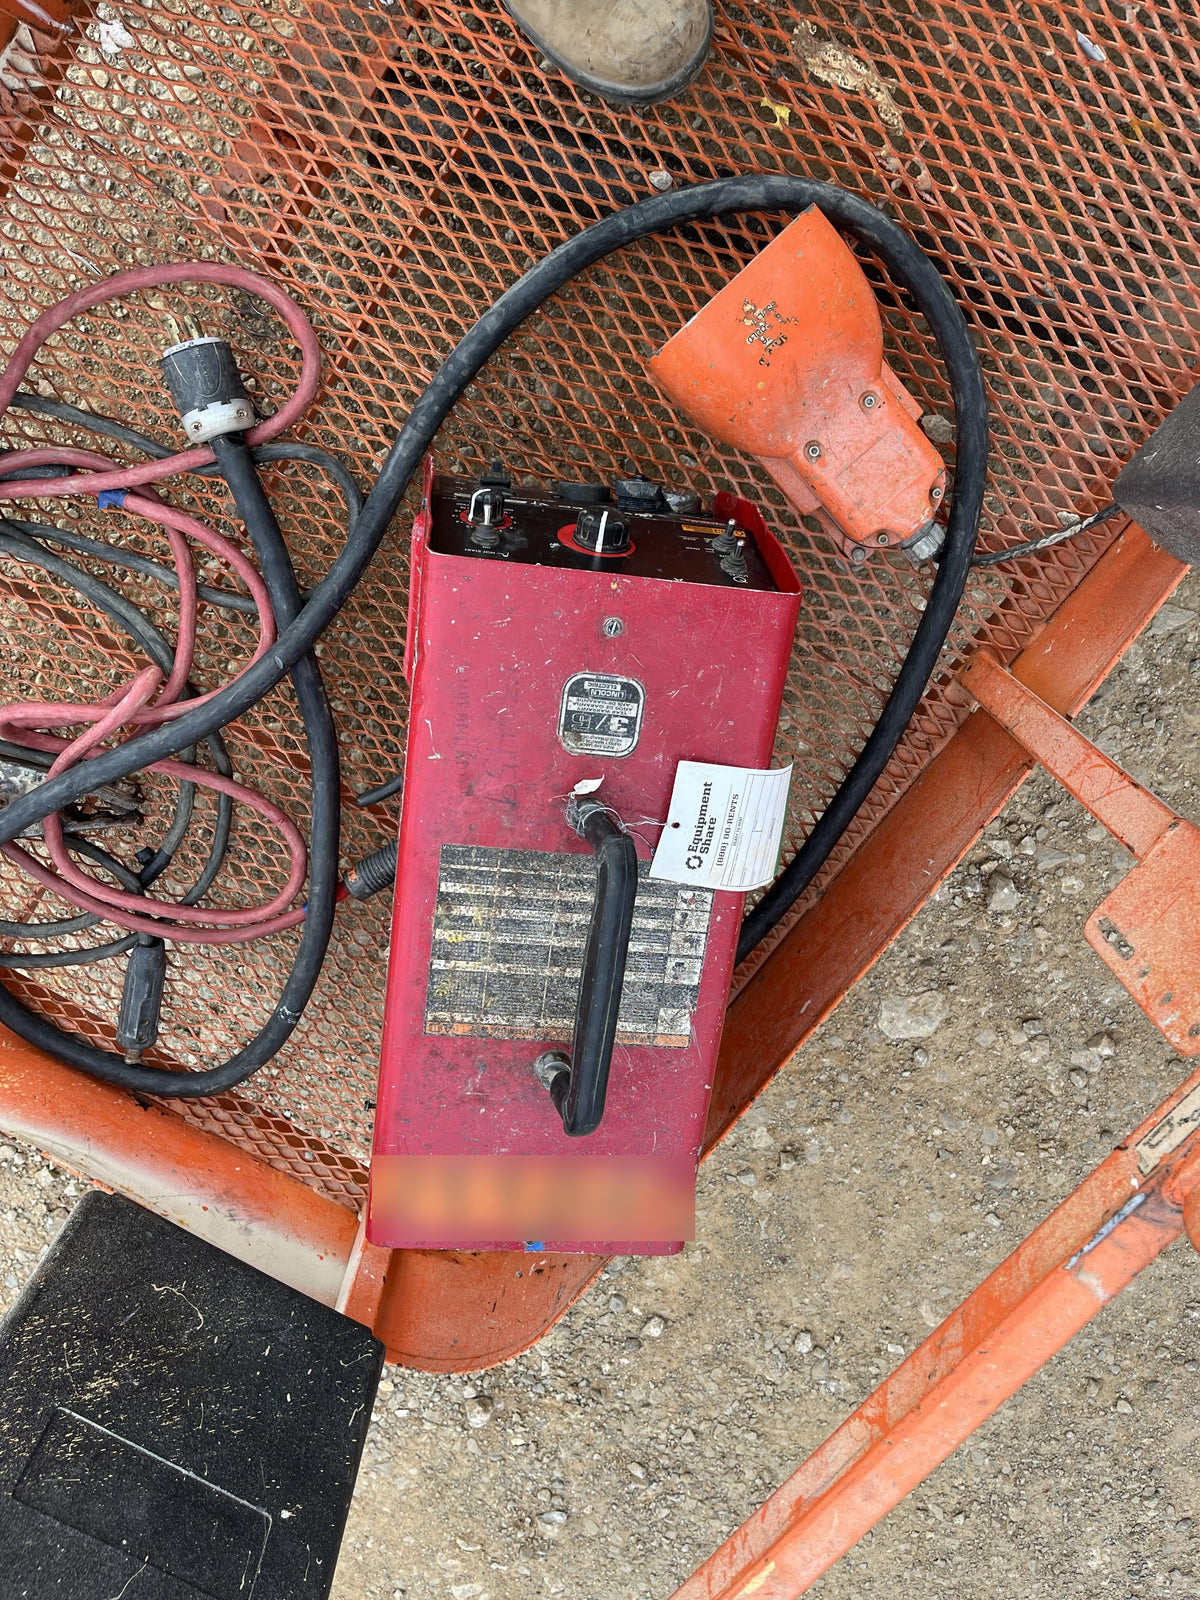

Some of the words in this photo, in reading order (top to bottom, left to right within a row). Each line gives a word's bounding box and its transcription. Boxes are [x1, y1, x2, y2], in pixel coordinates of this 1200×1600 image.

[587, 682, 617, 690] ELECTRIC
[590, 689, 624, 698] LINCOLN
[686, 781, 713, 853] Equipment
[698, 816, 717, 854] Share
[716, 841, 729, 867] (888)
